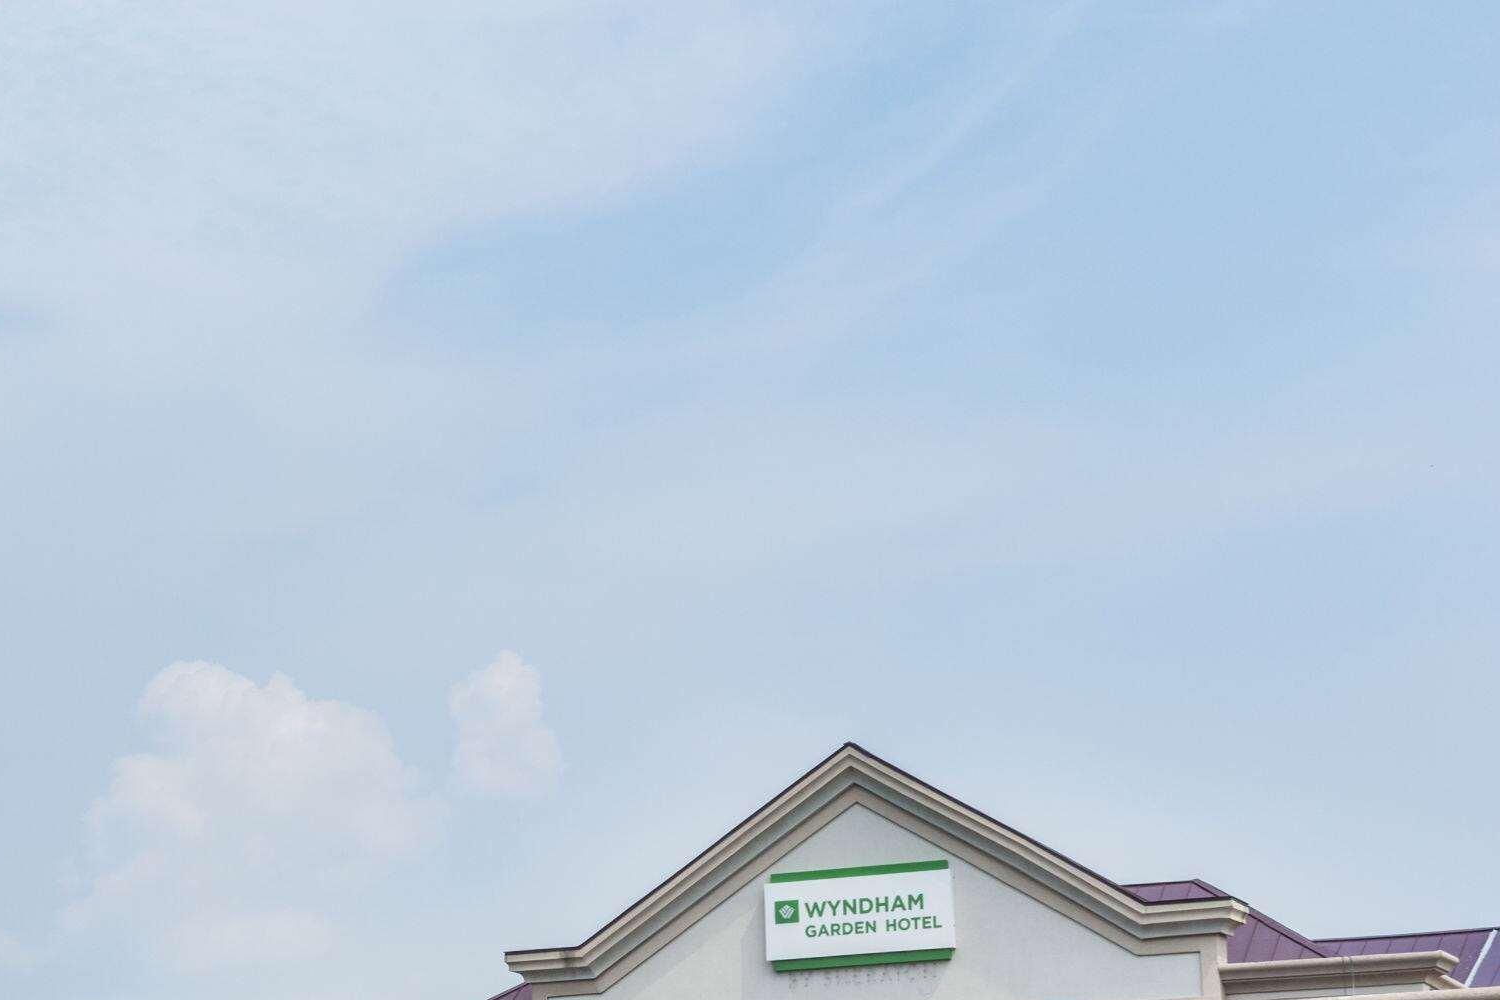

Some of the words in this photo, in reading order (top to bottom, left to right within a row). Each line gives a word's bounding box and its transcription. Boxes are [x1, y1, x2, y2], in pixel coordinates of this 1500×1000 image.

[804, 893, 925, 918] WYNDHAM
[805, 920, 877, 938] GARDEN
[885, 915, 943, 932] HOTEL
